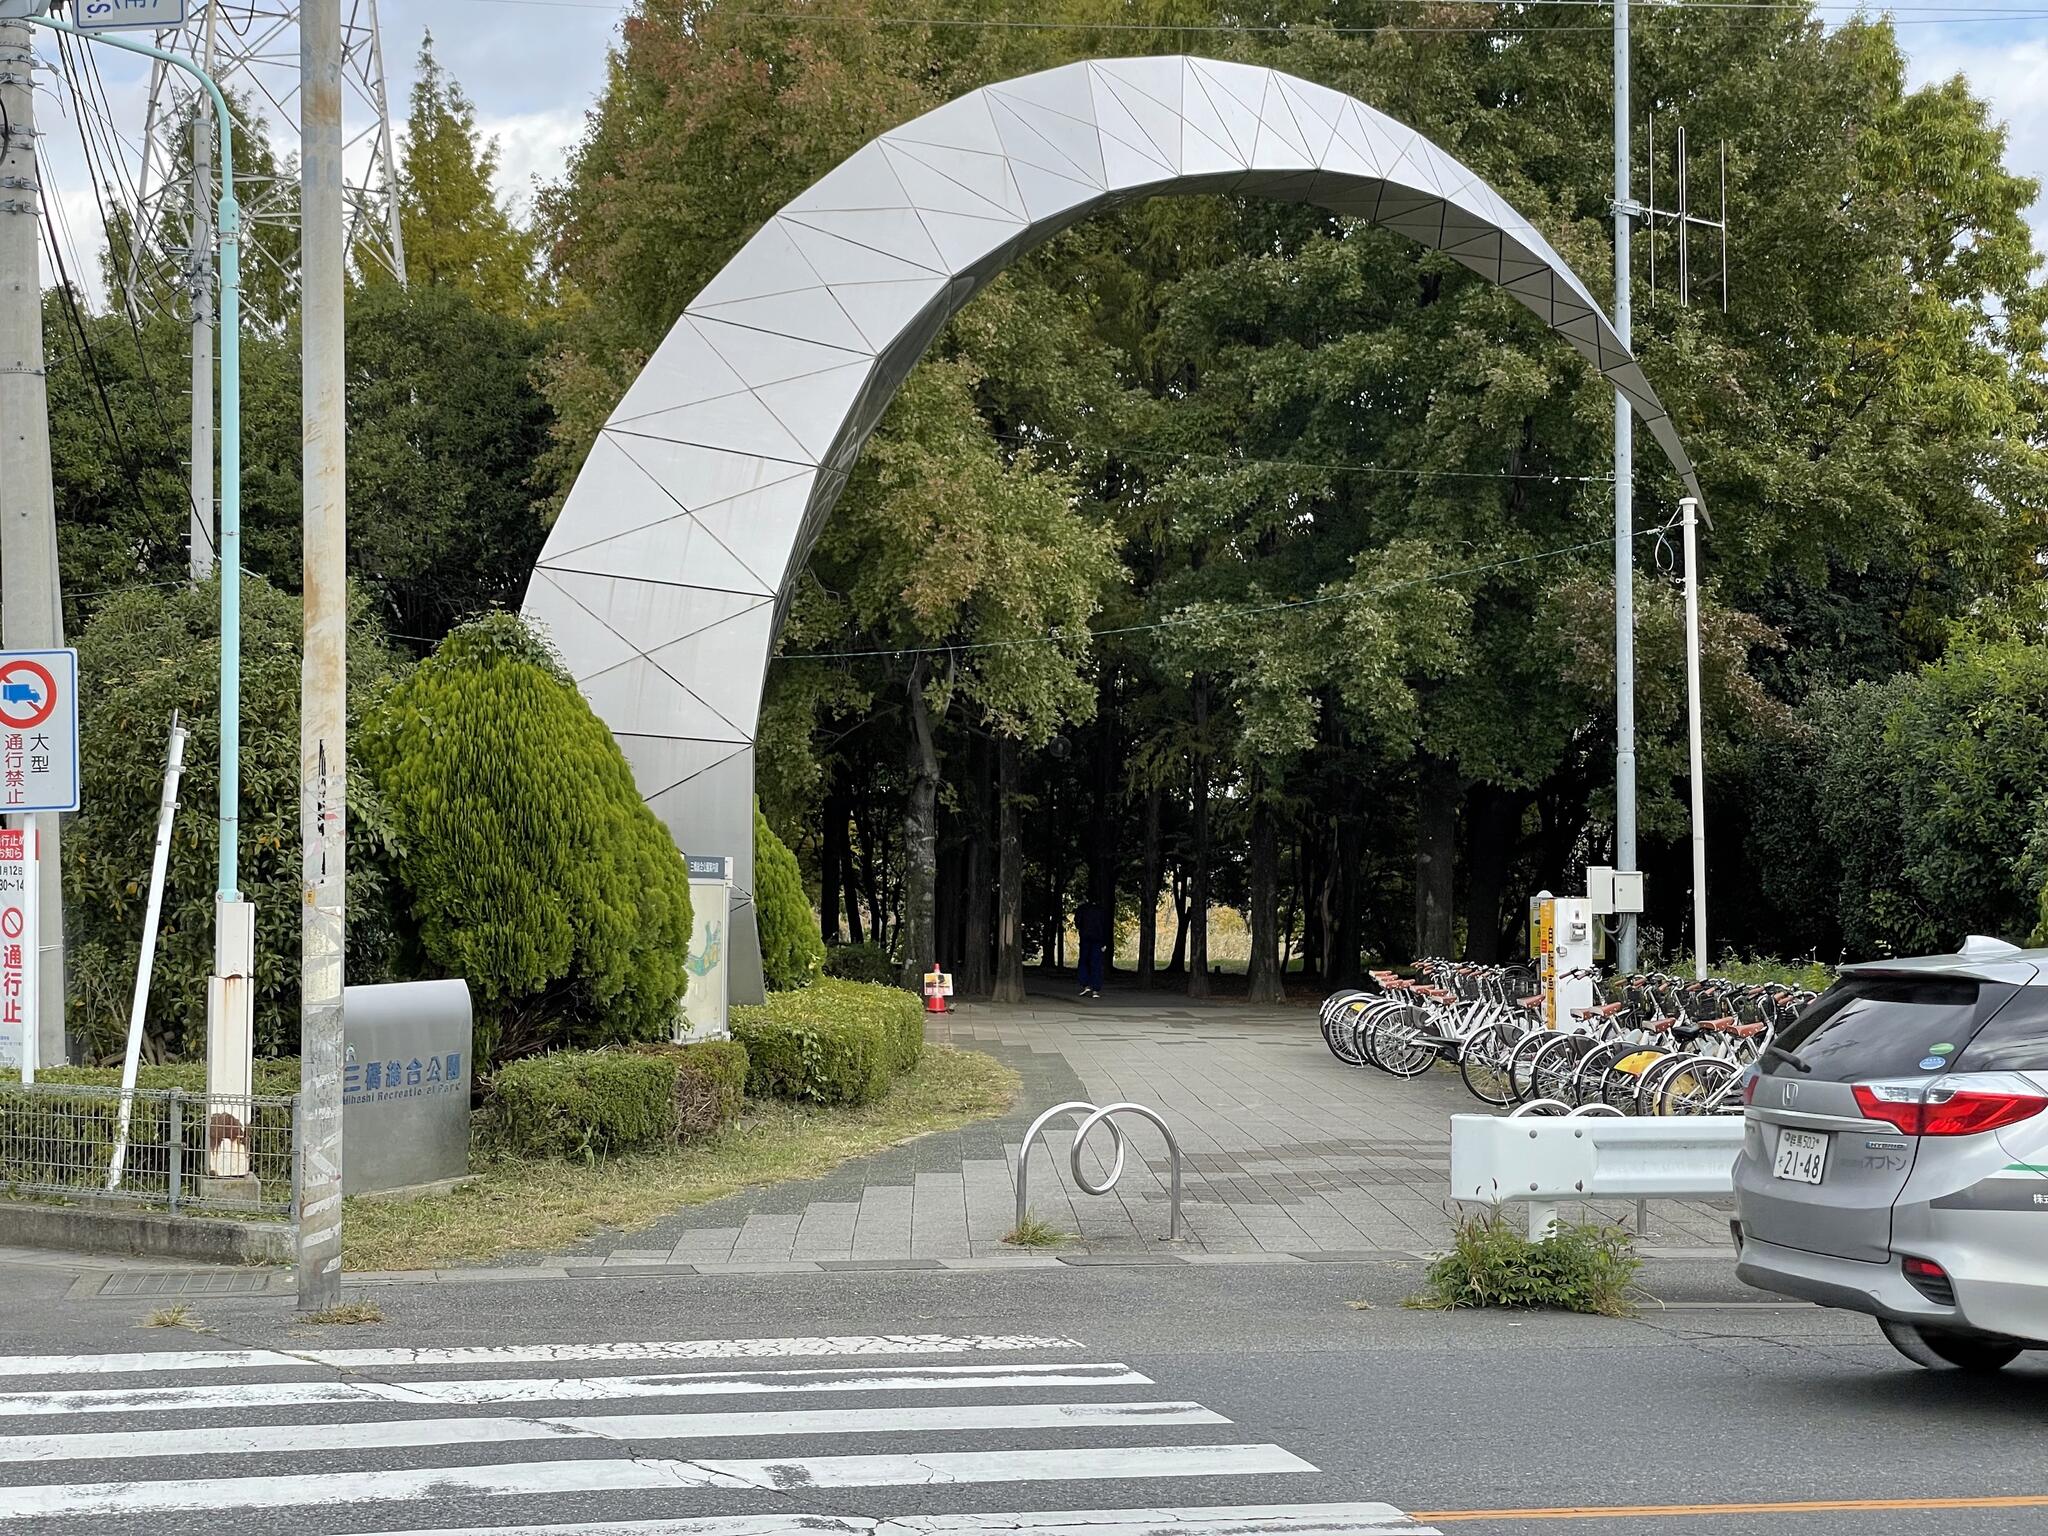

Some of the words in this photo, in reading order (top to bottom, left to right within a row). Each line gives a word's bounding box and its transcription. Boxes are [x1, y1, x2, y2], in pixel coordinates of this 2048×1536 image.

[5, 734, 24, 804] 通行禁止
[30, 733, 49, 773] 大型
[3, 944, 22, 1023] 通行止
[343, 1053, 461, 1092] 三橋総合公園
